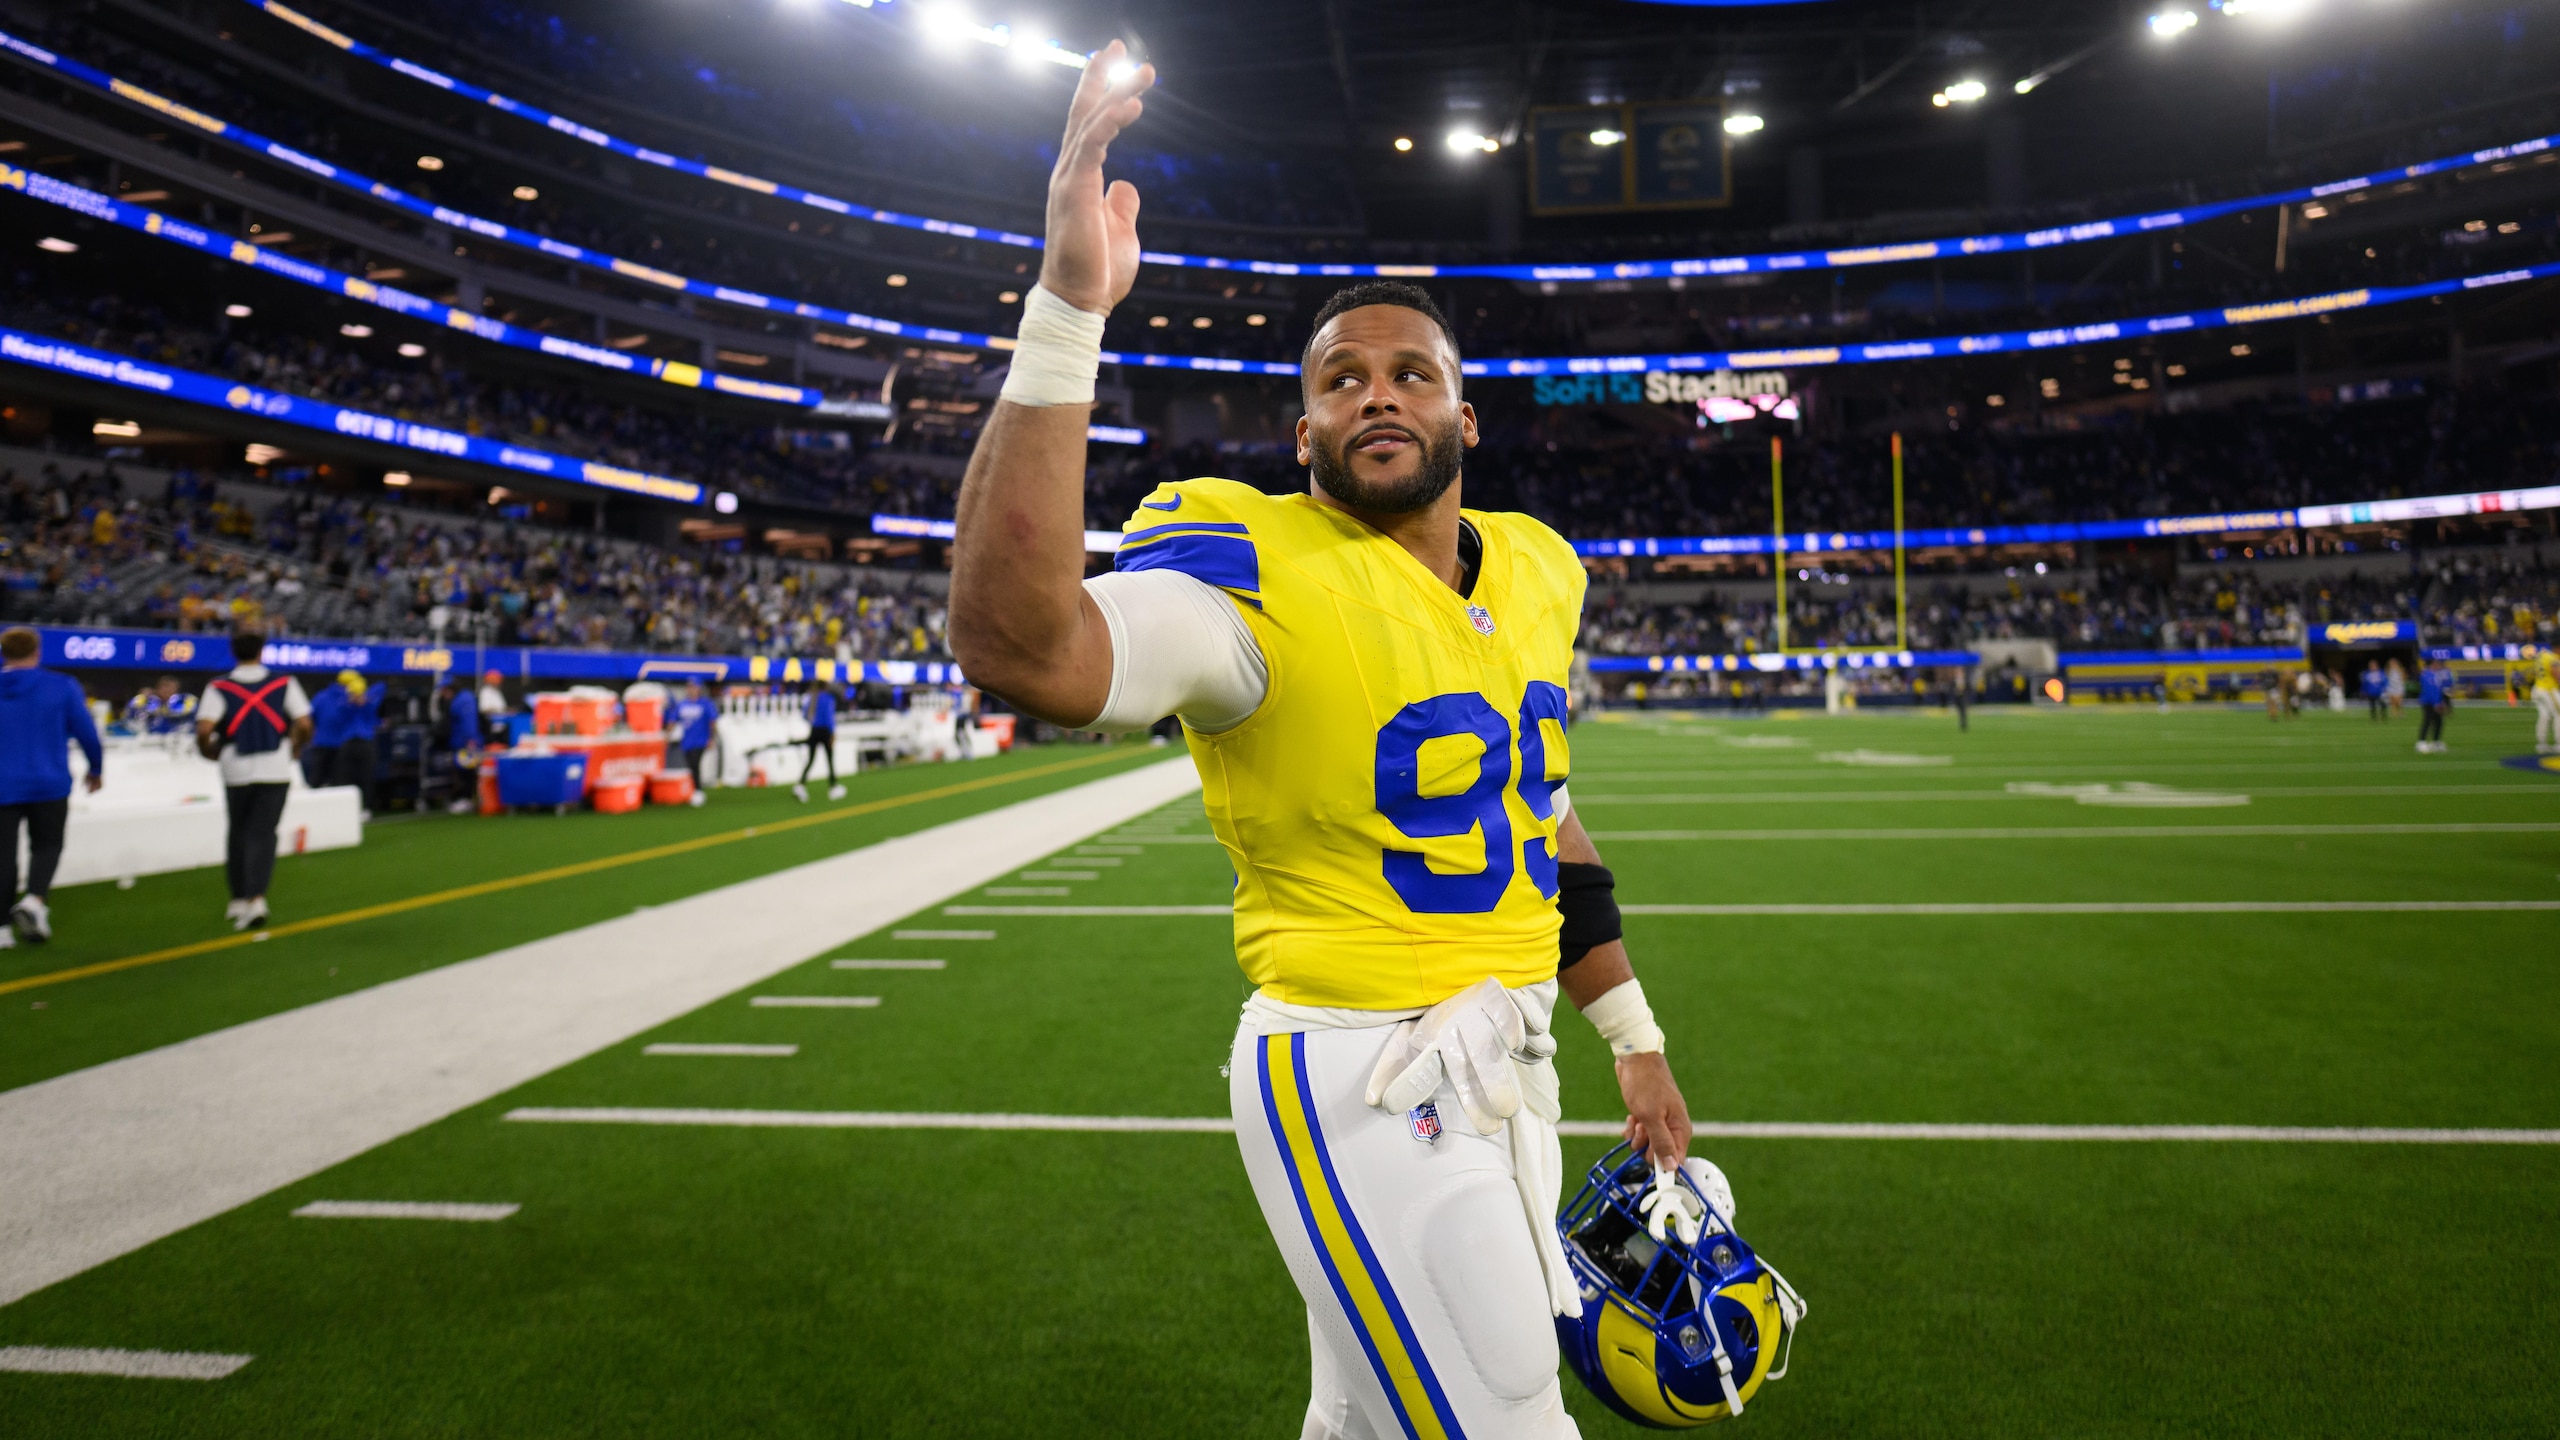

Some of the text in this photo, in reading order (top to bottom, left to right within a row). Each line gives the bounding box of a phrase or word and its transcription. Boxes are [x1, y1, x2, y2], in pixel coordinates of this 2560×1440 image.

[1, 334, 174, 391] Next Home Game
[1533, 369, 1788, 405] SoFi Stadium
[2325, 621, 2399, 644] RAMS
[402, 648, 453, 672] RAMS
[1375, 681, 1569, 914] 99
[1415, 1117, 1440, 1136] NFL
